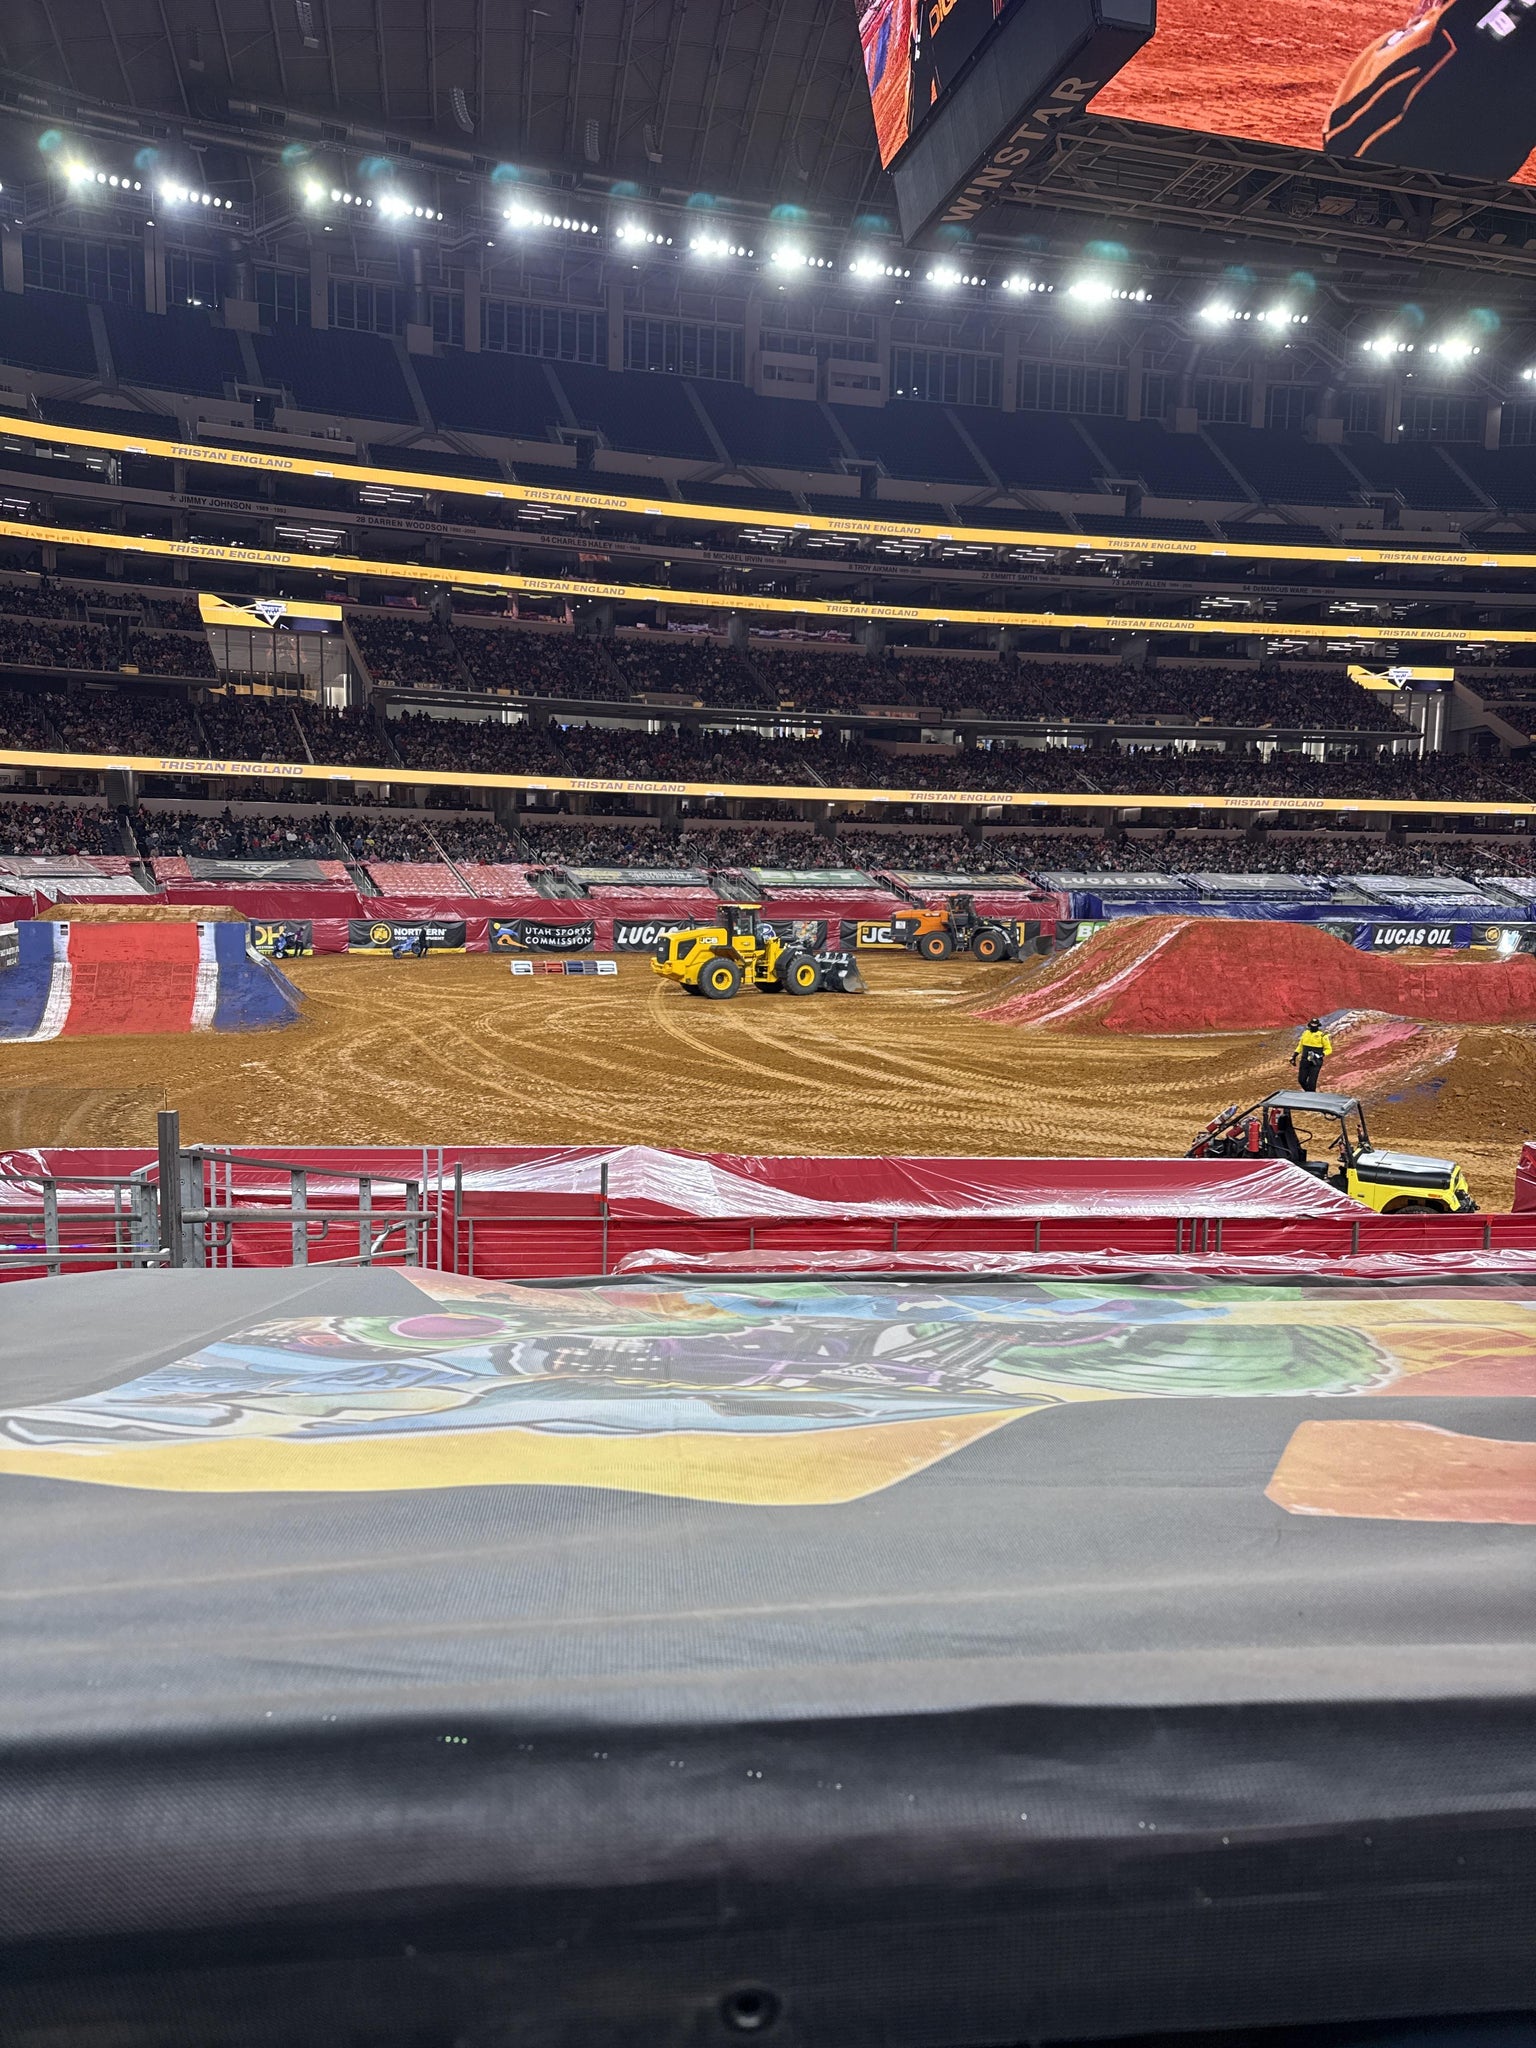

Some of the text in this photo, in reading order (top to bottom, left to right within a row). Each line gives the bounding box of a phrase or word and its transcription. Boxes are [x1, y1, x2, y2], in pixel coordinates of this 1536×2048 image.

[941, 77, 1098, 221] WINSTAR
[170, 446, 293, 468] TRISTAN ENGLAND
[179, 495, 207, 505] JIMMY
[209, 499, 251, 510] JOHNSON
[524, 490, 627, 507] TRISTAN ENGLAND
[368, 517, 403, 527] DARREN
[405, 521, 448, 532] WOODSON
[828, 521, 921, 534] TRISTAN ENGLAND
[552, 537, 587, 547] CHARLES
[588, 540, 613, 549] HALEY
[1108, 540, 1197, 551] TRISTAN ENGLAND
[169, 543, 291, 563] TRISTAN ENGLAND
[713, 552, 742, 561] MICHAEL
[1378, 553, 1467, 563] TRISTAN ENGLAND
[522, 580, 625, 595] TRISTAN ENGLAND
[826, 605, 918, 617] TRISTAN ENGLAND
[1106, 619, 1195, 629] TRISTAN ENGLAND
[1378, 629, 1419, 637] TRISTAN
[160, 760, 303, 775] TRISTAN ENGLAND
[570, 780, 686, 792] TRISTAN ENGLAND
[960, 794, 1013, 802] ENGLAND
[1273, 800, 1324, 808] ENGLAND
[1060, 877, 1127, 885] LUCAS
[394, 928, 446, 936] NORTERN
[525, 927, 592, 936] UTAH SPORTS
[1374, 929, 1451, 945] LUCAS OIL
[525, 937, 591, 945] COMMISSION
